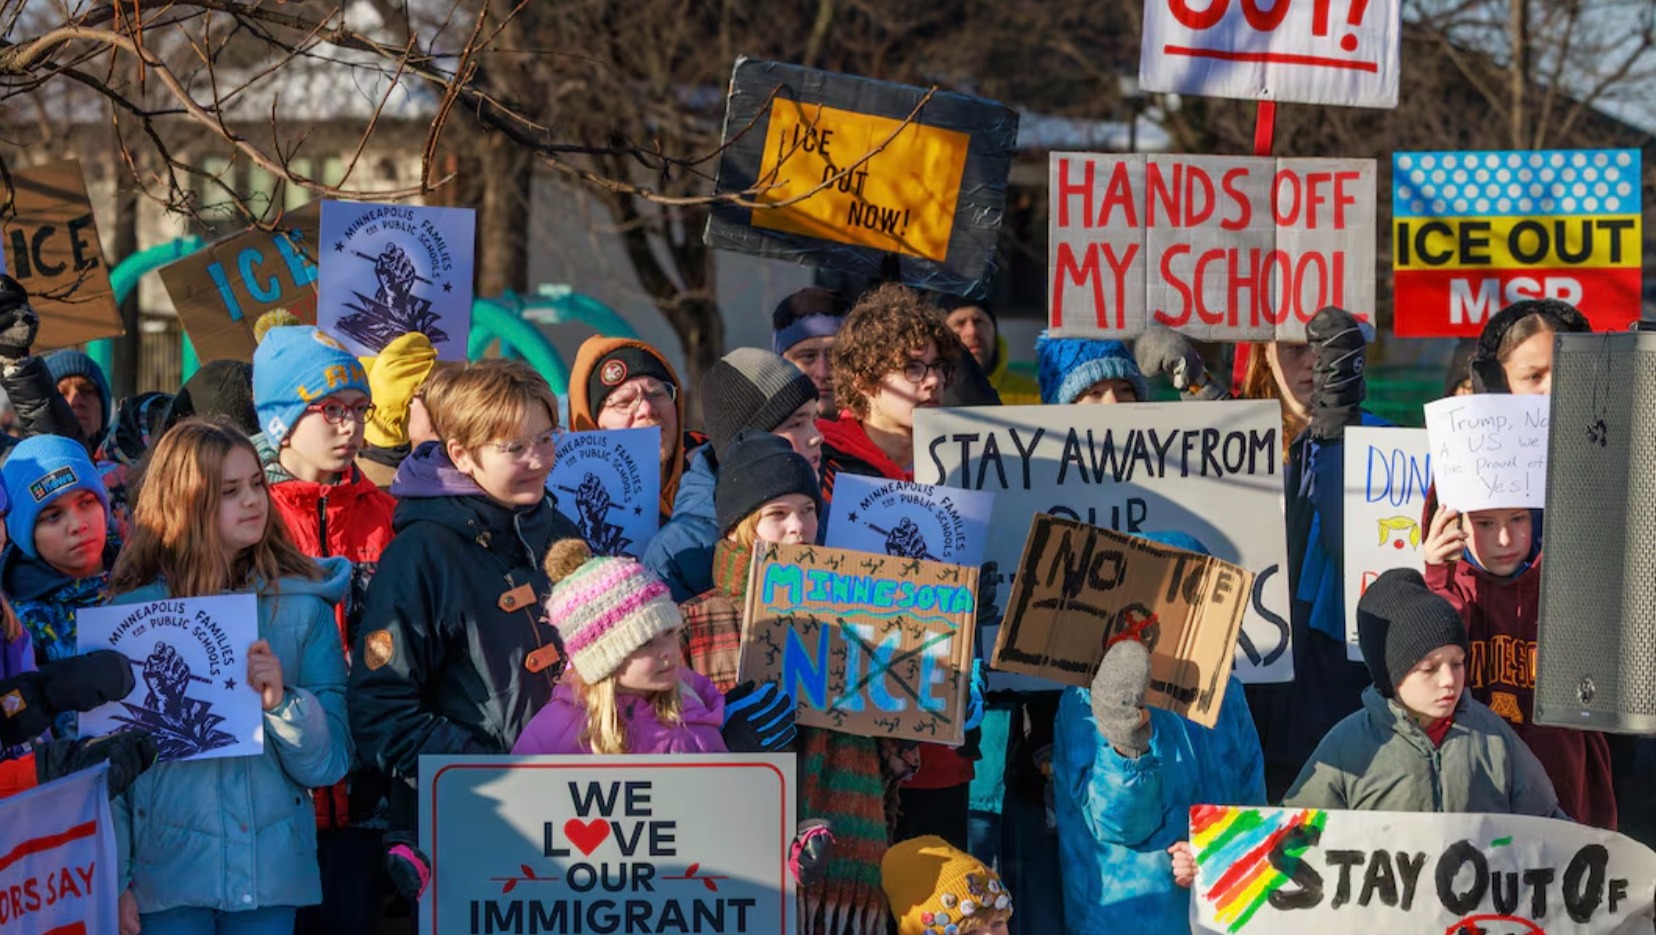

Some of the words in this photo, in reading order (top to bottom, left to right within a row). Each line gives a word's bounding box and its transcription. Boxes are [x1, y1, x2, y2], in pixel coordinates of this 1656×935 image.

[792, 123, 834, 155] ICE
[821, 165, 869, 197] OUT
[1058, 158, 1252, 231] HANDS
[1270, 169, 1360, 229] OFF
[10, 213, 99, 280] ICE
[344, 206, 415, 241] MINNEAPOLIS
[420, 219, 452, 272] FAMILIES
[848, 201, 911, 236] NOW!
[1397, 221, 1492, 266] ICE
[1508, 219, 1635, 265] OUT
[382, 219, 418, 236] PUBLIC
[417, 233, 441, 279] SCHOOLS
[1052, 242, 1140, 330] MY
[1153, 243, 1369, 328] SCHOOL
[1447, 406, 1513, 433] Trump,
[1468, 432, 1503, 453] US
[550, 434, 607, 474] NNEAPOLIS
[614, 443, 643, 494] FAMILIES
[580, 448, 611, 462] PUBLIC
[611, 458, 632, 503] SCHOOLS
[928, 428, 1046, 491] STAY
[1366, 444, 1431, 507] DON
[1480, 471, 1530, 499] Yes!
[860, 481, 935, 511] MINNEAPOLIS
[940, 496, 966, 551] FAMILIES
[900, 493, 936, 512] PUBLIC
[935, 510, 953, 559] SCHOOLS
[762, 562, 975, 614] MINNESOTA
[1046, 528, 1128, 599] NO
[108, 601, 186, 646] MINNEAPOLIS
[194, 609, 235, 666] FAMILIES
[150, 615, 191, 631] PUBLIC
[191, 626, 221, 676] SCHOOLS
[782, 622, 952, 712] NICE
[568, 781, 653, 818] WE
[46, 861, 95, 906] SAY
[566, 862, 657, 893] OUR
[1268, 822, 1427, 911] STAY
[1435, 838, 1555, 920] OUT
[1563, 843, 1629, 923] OF
[470, 898, 756, 935] IMMIGRANT
